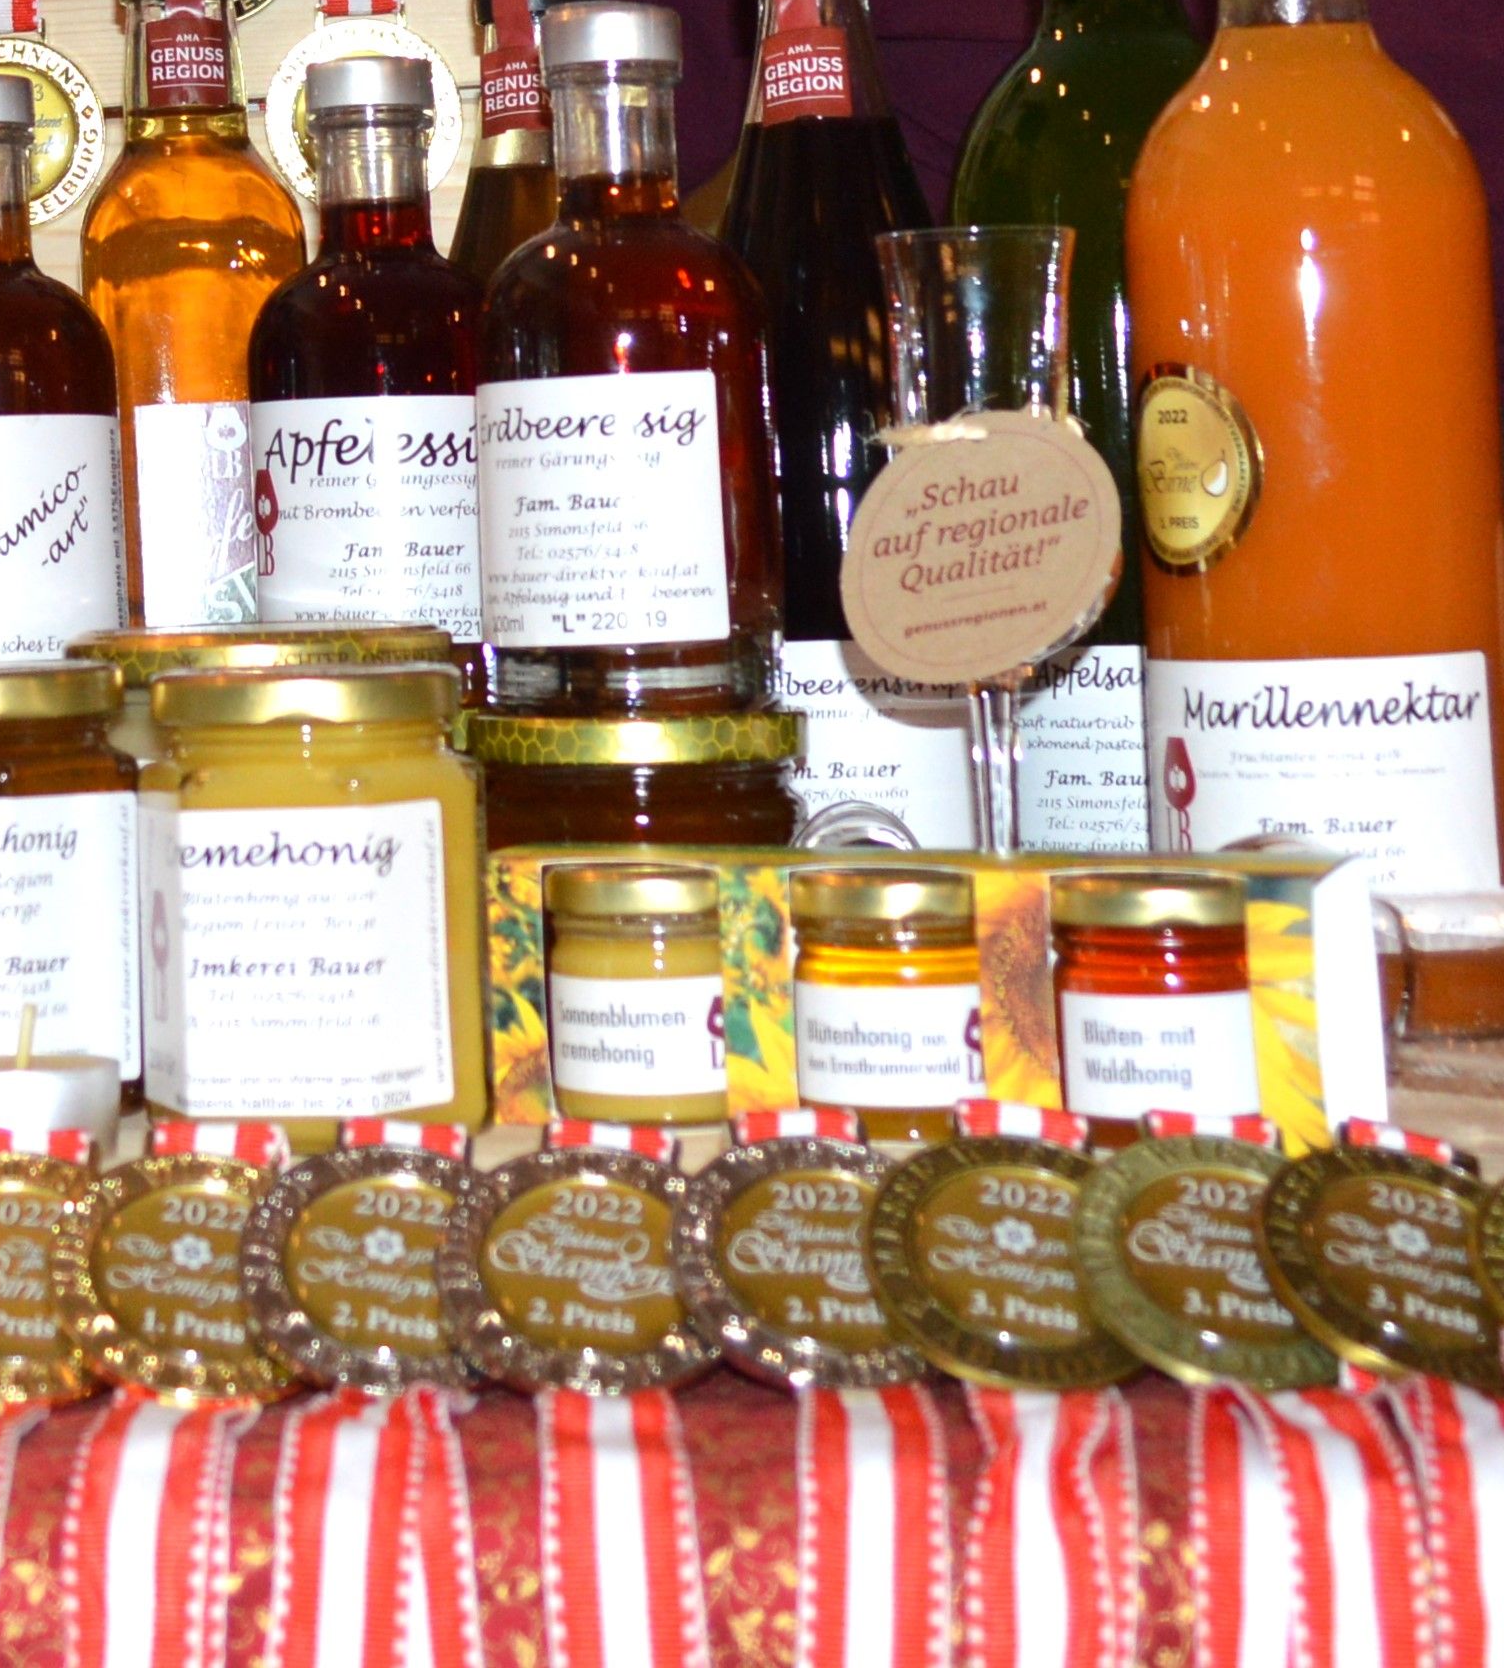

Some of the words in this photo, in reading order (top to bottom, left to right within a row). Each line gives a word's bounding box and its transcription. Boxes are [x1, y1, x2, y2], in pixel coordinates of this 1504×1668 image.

[175, 33, 200, 43] AMA
[787, 43, 813, 56] AMA
[150, 46, 224, 64] GENUSS
[504, 61, 528, 71] AMA
[764, 56, 844, 82] GENUSS
[152, 64, 224, 81] REGION
[484, 74, 542, 96] GENUS
[765, 75, 844, 100] REGION
[480, 405, 706, 446] Erdbeeresig
[1158, 410, 1188, 424] 2022
[308, 473, 360, 488] reiner
[514, 496, 560, 517] Fam.
[873, 521, 932, 560] auf
[936, 494, 1090, 548] regionale
[405, 541, 466, 557] Bauer
[900, 535, 1062, 594] Qualität!“
[453, 620, 481, 637] 221
[903, 601, 1048, 640] genussregionen.at
[1037, 655, 1143, 700] Apfelsa
[1182, 680, 1481, 733] Marillennektar
[827, 761, 902, 779] Bauer
[1044, 769, 1092, 788] Fam.
[5, 953, 70, 975] Bauer
[189, 955, 297, 979] Imkerei
[309, 956, 387, 977] Bauer
[1160, 1026, 1195, 1046] mit
[1085, 1057, 1192, 1091] Waldhonig
[353, 1189, 445, 1225] 2022
[550, 1188, 644, 1225] 2022
[769, 1182, 864, 1213] 2022
[977, 1179, 1072, 1217] 2022
[1367, 1180, 1464, 1229] 2022
[161, 1196, 250, 1232] 2022
[365, 1306, 438, 1341] Preis
[561, 1301, 636, 1336] Preis
[1004, 1297, 1079, 1332] Preis
[1216, 1291, 1294, 1326] Preis
[1402, 1291, 1480, 1333] Preis
[175, 1310, 246, 1345] Preis
